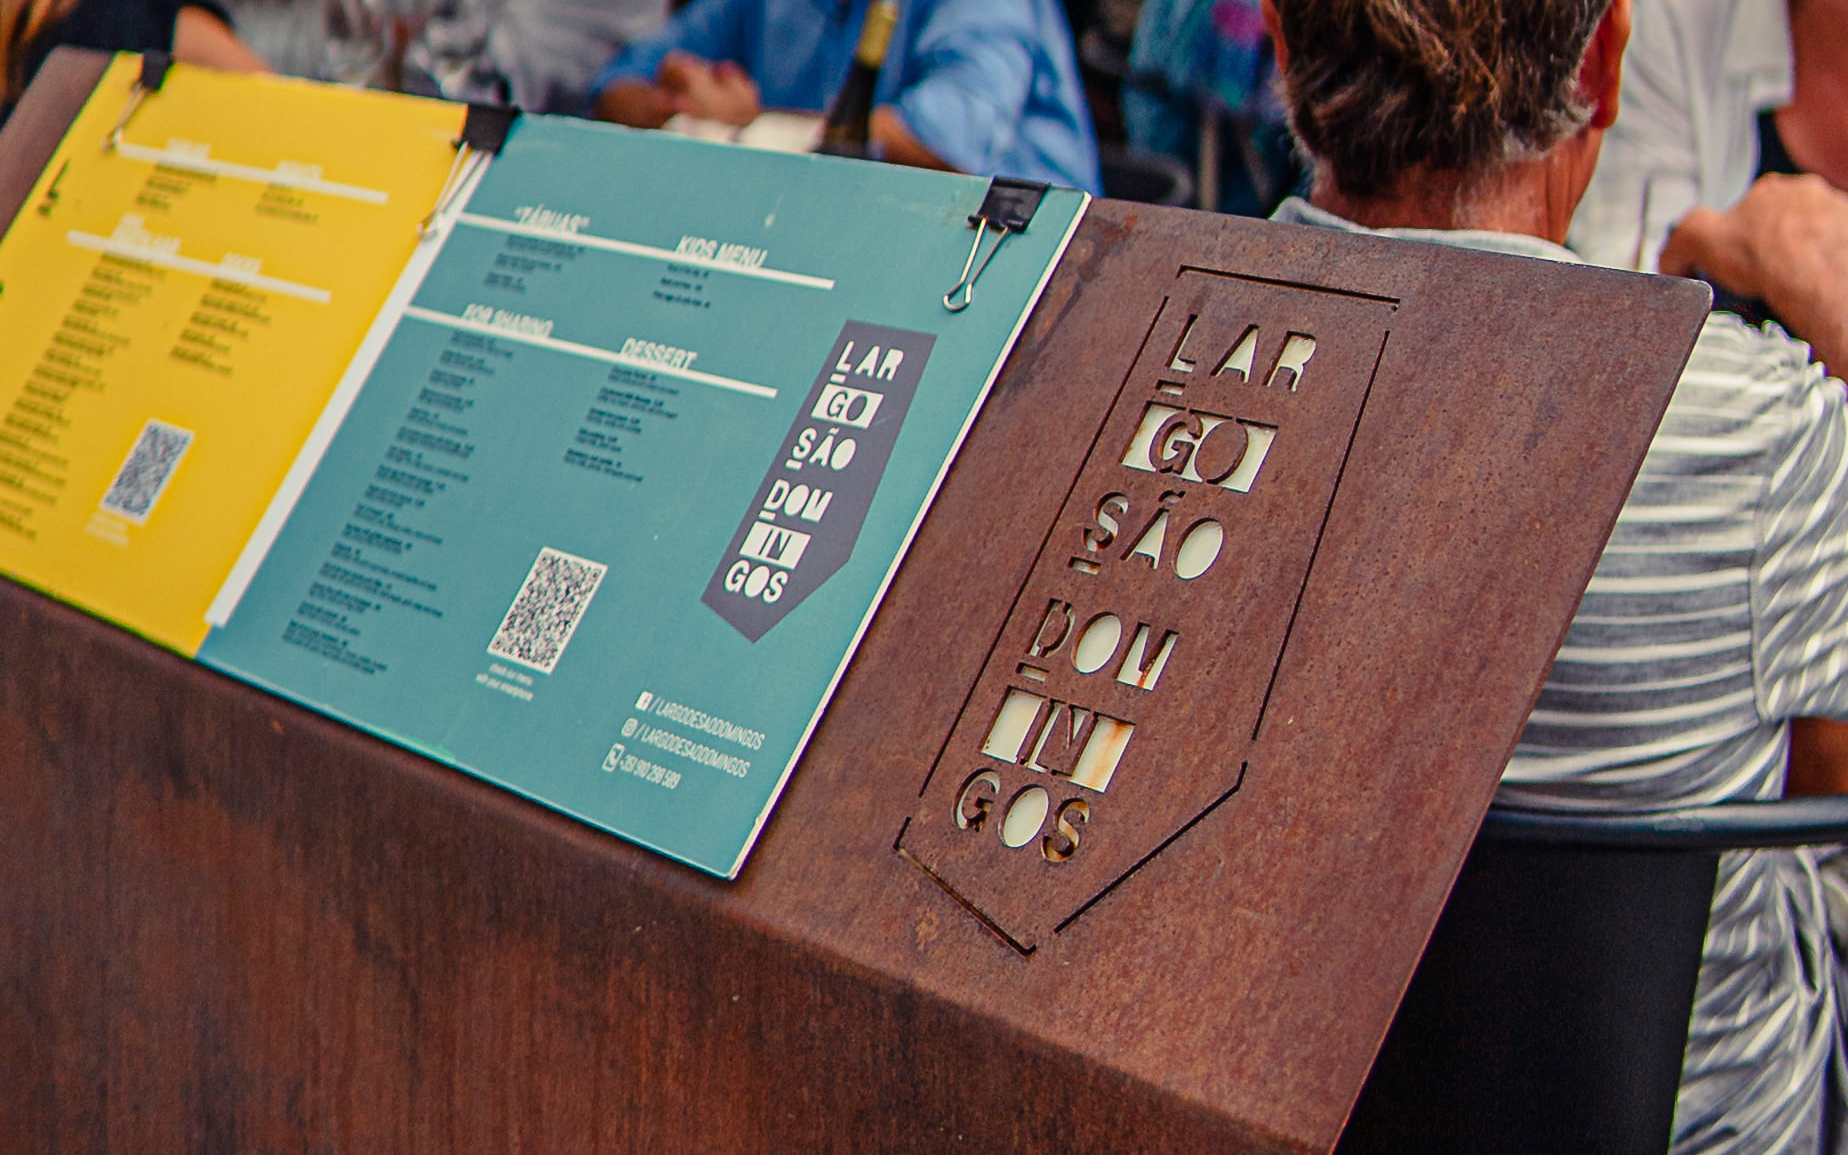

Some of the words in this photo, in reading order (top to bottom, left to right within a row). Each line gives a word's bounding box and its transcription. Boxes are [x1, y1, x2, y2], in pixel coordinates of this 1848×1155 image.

[675, 235, 718, 260] KIDS
[713, 242, 769, 268] MENU
[463, 303, 494, 325] FOR
[620, 337, 698, 371] DESSERT
[836, 341, 904, 381] LAR
[1165, 314, 1317, 392] LAR
[822, 388, 871, 424] GO
[792, 427, 857, 471] SÃO
[1146, 406, 1253, 486] GO
[763, 479, 834, 523] DOM
[1083, 490, 1225, 580] SÃO
[724, 559, 789, 603] GOS
[1026, 597, 1179, 691] DOM
[950, 767, 1090, 863] GOS
